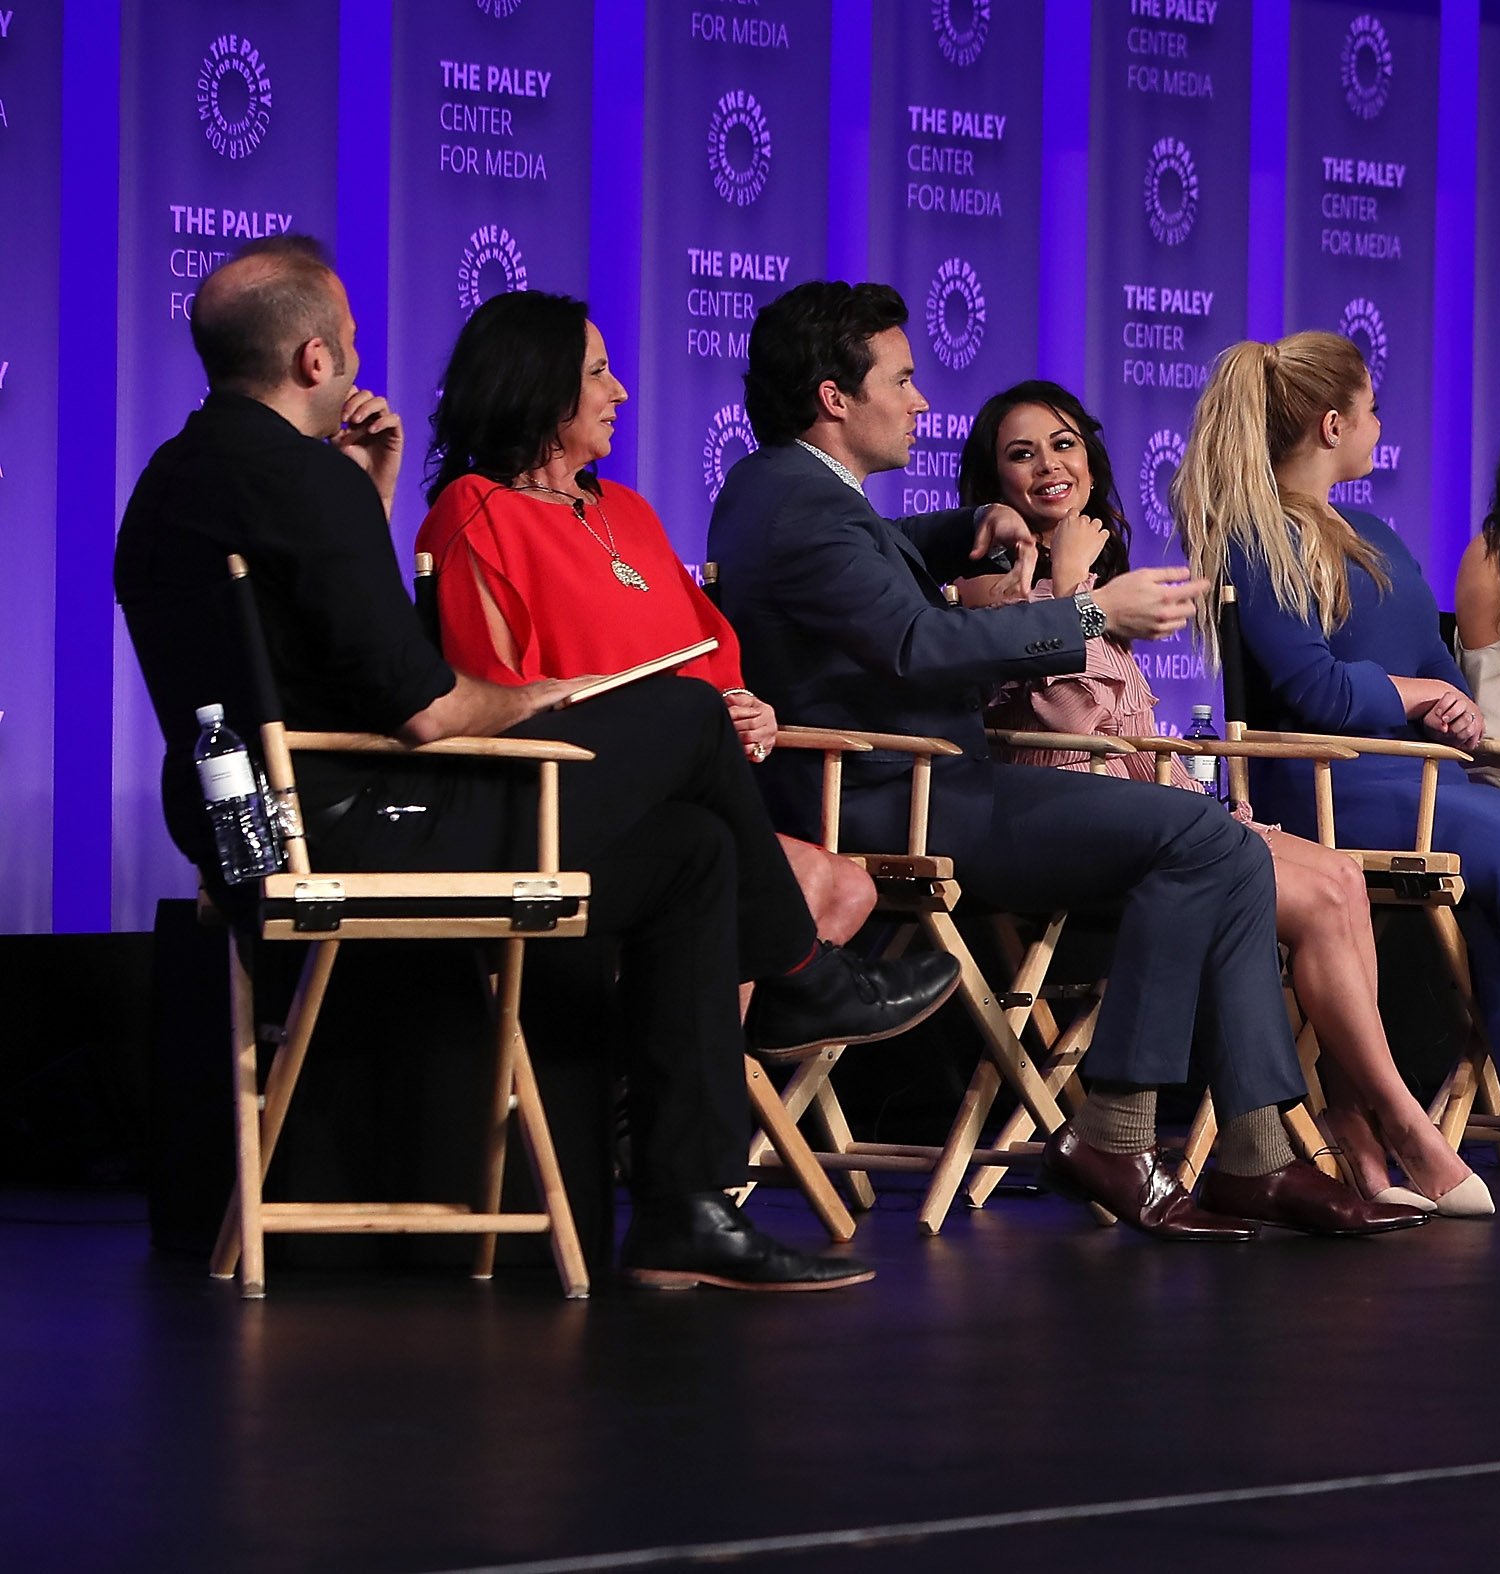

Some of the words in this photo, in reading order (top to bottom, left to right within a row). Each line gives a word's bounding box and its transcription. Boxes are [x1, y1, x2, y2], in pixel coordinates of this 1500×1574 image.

[1128, 0, 1161, 19] THE
[1164, 0, 1218, 25] PALEY
[691, 12, 727, 42] FOR
[732, 17, 790, 49] MEDIA
[1127, 27, 1188, 59] CENTER
[209, 34, 238, 60] THE
[197, 58, 214, 120] MEDIA
[240, 38, 272, 108] PALEY
[440, 61, 480, 92] THE
[487, 65, 551, 98] PALEY
[1127, 65, 1159, 93] FOR
[1163, 69, 1214, 99] MEDIA
[229, 110, 270, 160] CENTER
[440, 102, 513, 137] CENTER
[719, 90, 745, 115] THE
[746, 94, 771, 159] PALEY
[908, 105, 947, 135] THE
[951, 109, 1006, 140] PALEY
[205, 121, 227, 156] FOR
[440, 144, 479, 176] FOR
[485, 148, 547, 181] MEDIA
[907, 143, 974, 176] CENTER
[1322, 156, 1354, 184] THE
[1356, 160, 1406, 189] PALEY
[907, 182, 945, 212] FOR
[950, 187, 1002, 217] MEDIA
[1321, 192, 1378, 222] CENTER
[169, 204, 216, 236] THE
[222, 208, 293, 239] PALEY
[470, 224, 498, 251] THE
[1321, 228, 1353, 256] FOR
[1354, 232, 1403, 260] MEDIA
[457, 248, 475, 308] MEDIA
[687, 247, 723, 277] THE
[729, 251, 790, 282] PALEY
[171, 291, 196, 321] FO
[687, 288, 755, 320] CENTER
[938, 258, 960, 282] THE
[961, 262, 986, 322] PALEY
[1123, 284, 1157, 312] THE
[1160, 287, 1214, 316] PALEY
[687, 328, 723, 358] FOR
[1123, 321, 1185, 351] CENTER
[1123, 359, 1155, 387] FOR
[714, 404, 740, 430] THE
[916, 412, 943, 439] HE
[703, 428, 718, 486] MEDIA
[904, 449, 962, 478] CENTE
[1372, 445, 1401, 472] LEY
[903, 488, 940, 514] FOR
[1328, 479, 1374, 505] ENTER
[1155, 653, 1207, 680] MEDIA
